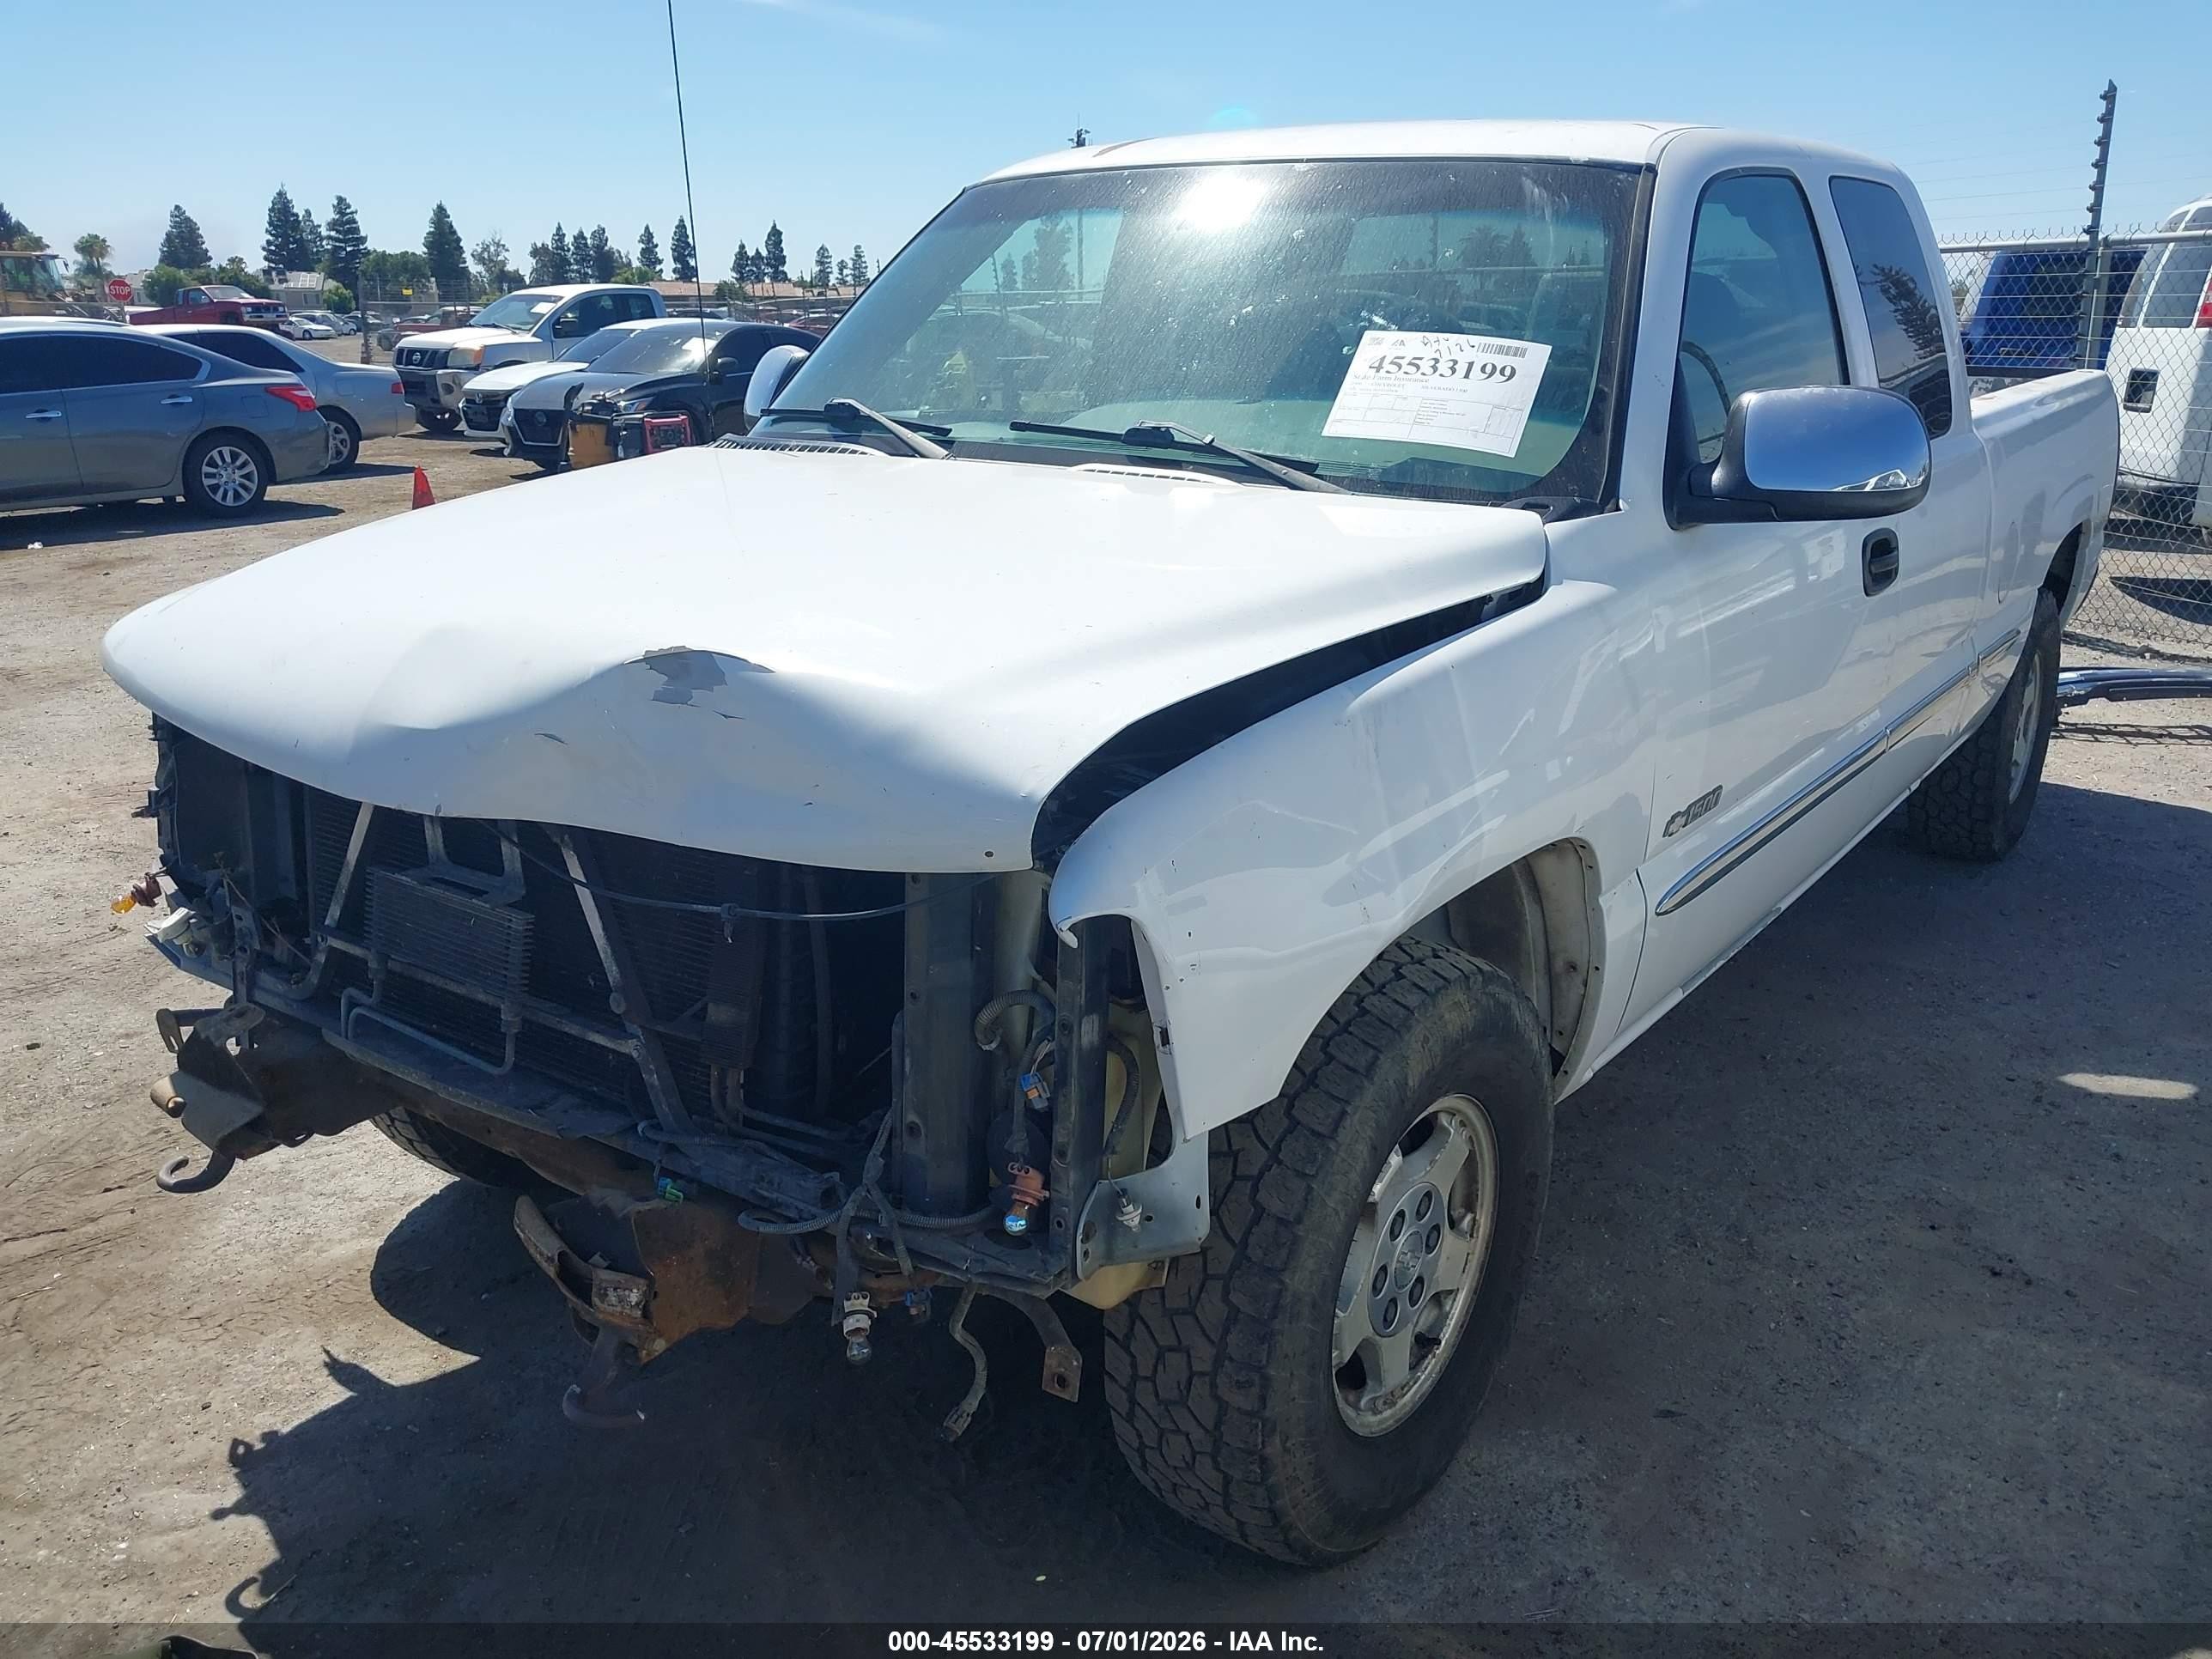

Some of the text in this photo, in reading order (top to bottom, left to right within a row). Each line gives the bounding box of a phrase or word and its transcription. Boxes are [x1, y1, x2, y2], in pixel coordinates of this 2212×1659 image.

[110, 285, 131, 295] STOP
[1369, 354, 1517, 385] 45533199
[1372, 374, 1393, 383] Farm
[1394, 375, 1430, 384] Insurance
[1687, 788, 1723, 825] 1500
